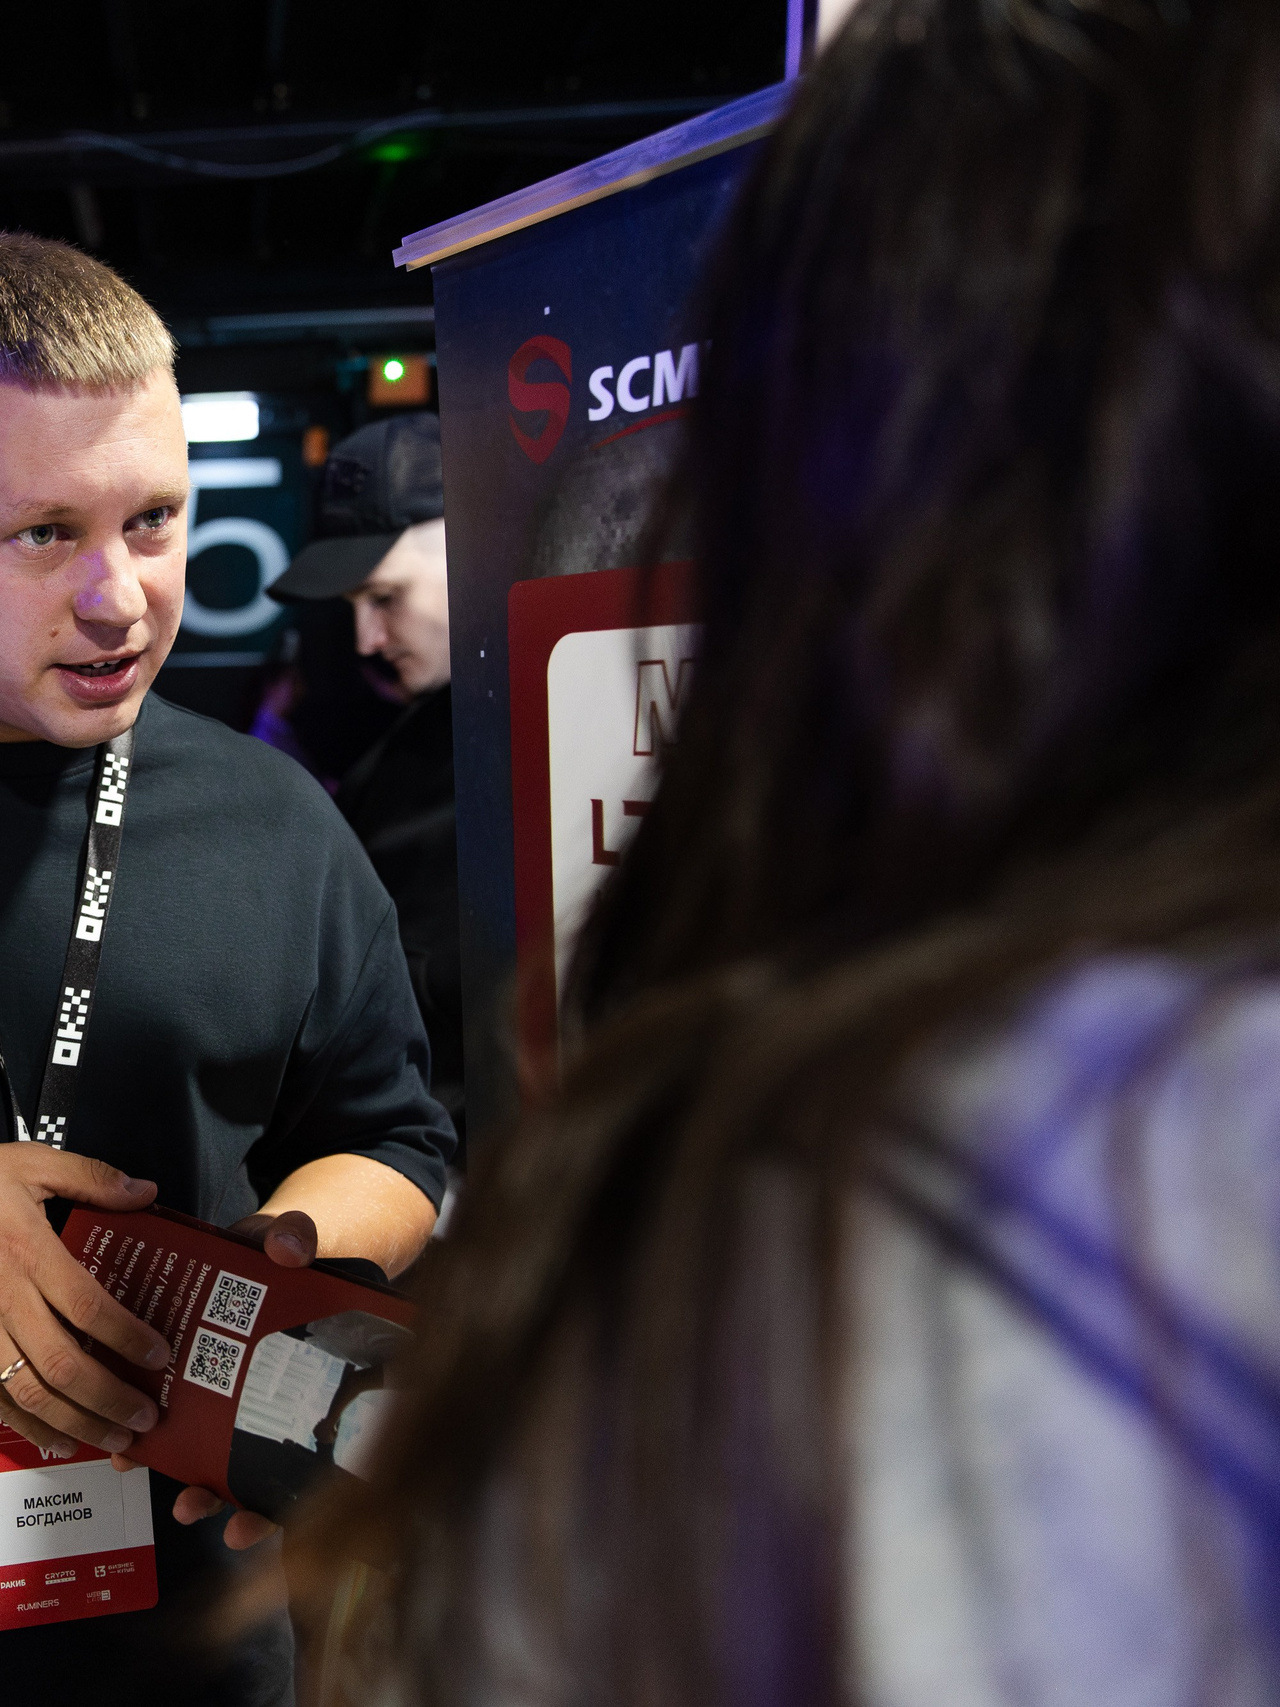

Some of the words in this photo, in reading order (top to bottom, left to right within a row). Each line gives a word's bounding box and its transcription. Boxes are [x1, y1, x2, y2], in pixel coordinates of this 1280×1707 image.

[588, 341, 702, 421] SCM
[83, 1225, 102, 1254] Russia
[96, 1229, 114, 1257] Офис
[114, 1236, 134, 1265] Russia
[123, 1241, 146, 1280] Филиал
[163, 1252, 178, 1276] Сайт
[134, 1248, 164, 1316] www.scminer.
[161, 1259, 197, 1341] scminer@scmin
[178, 1263, 212, 1331] Электронная
[160, 1374, 174, 1408] E-mail
[23, 1491, 83, 1510] МАКСИМ
[16, 1507, 93, 1528] БОГДАНОВ
[44, 1569, 76, 1580] CRYPTO
[16, 1599, 60, 1612] RUMINERS
